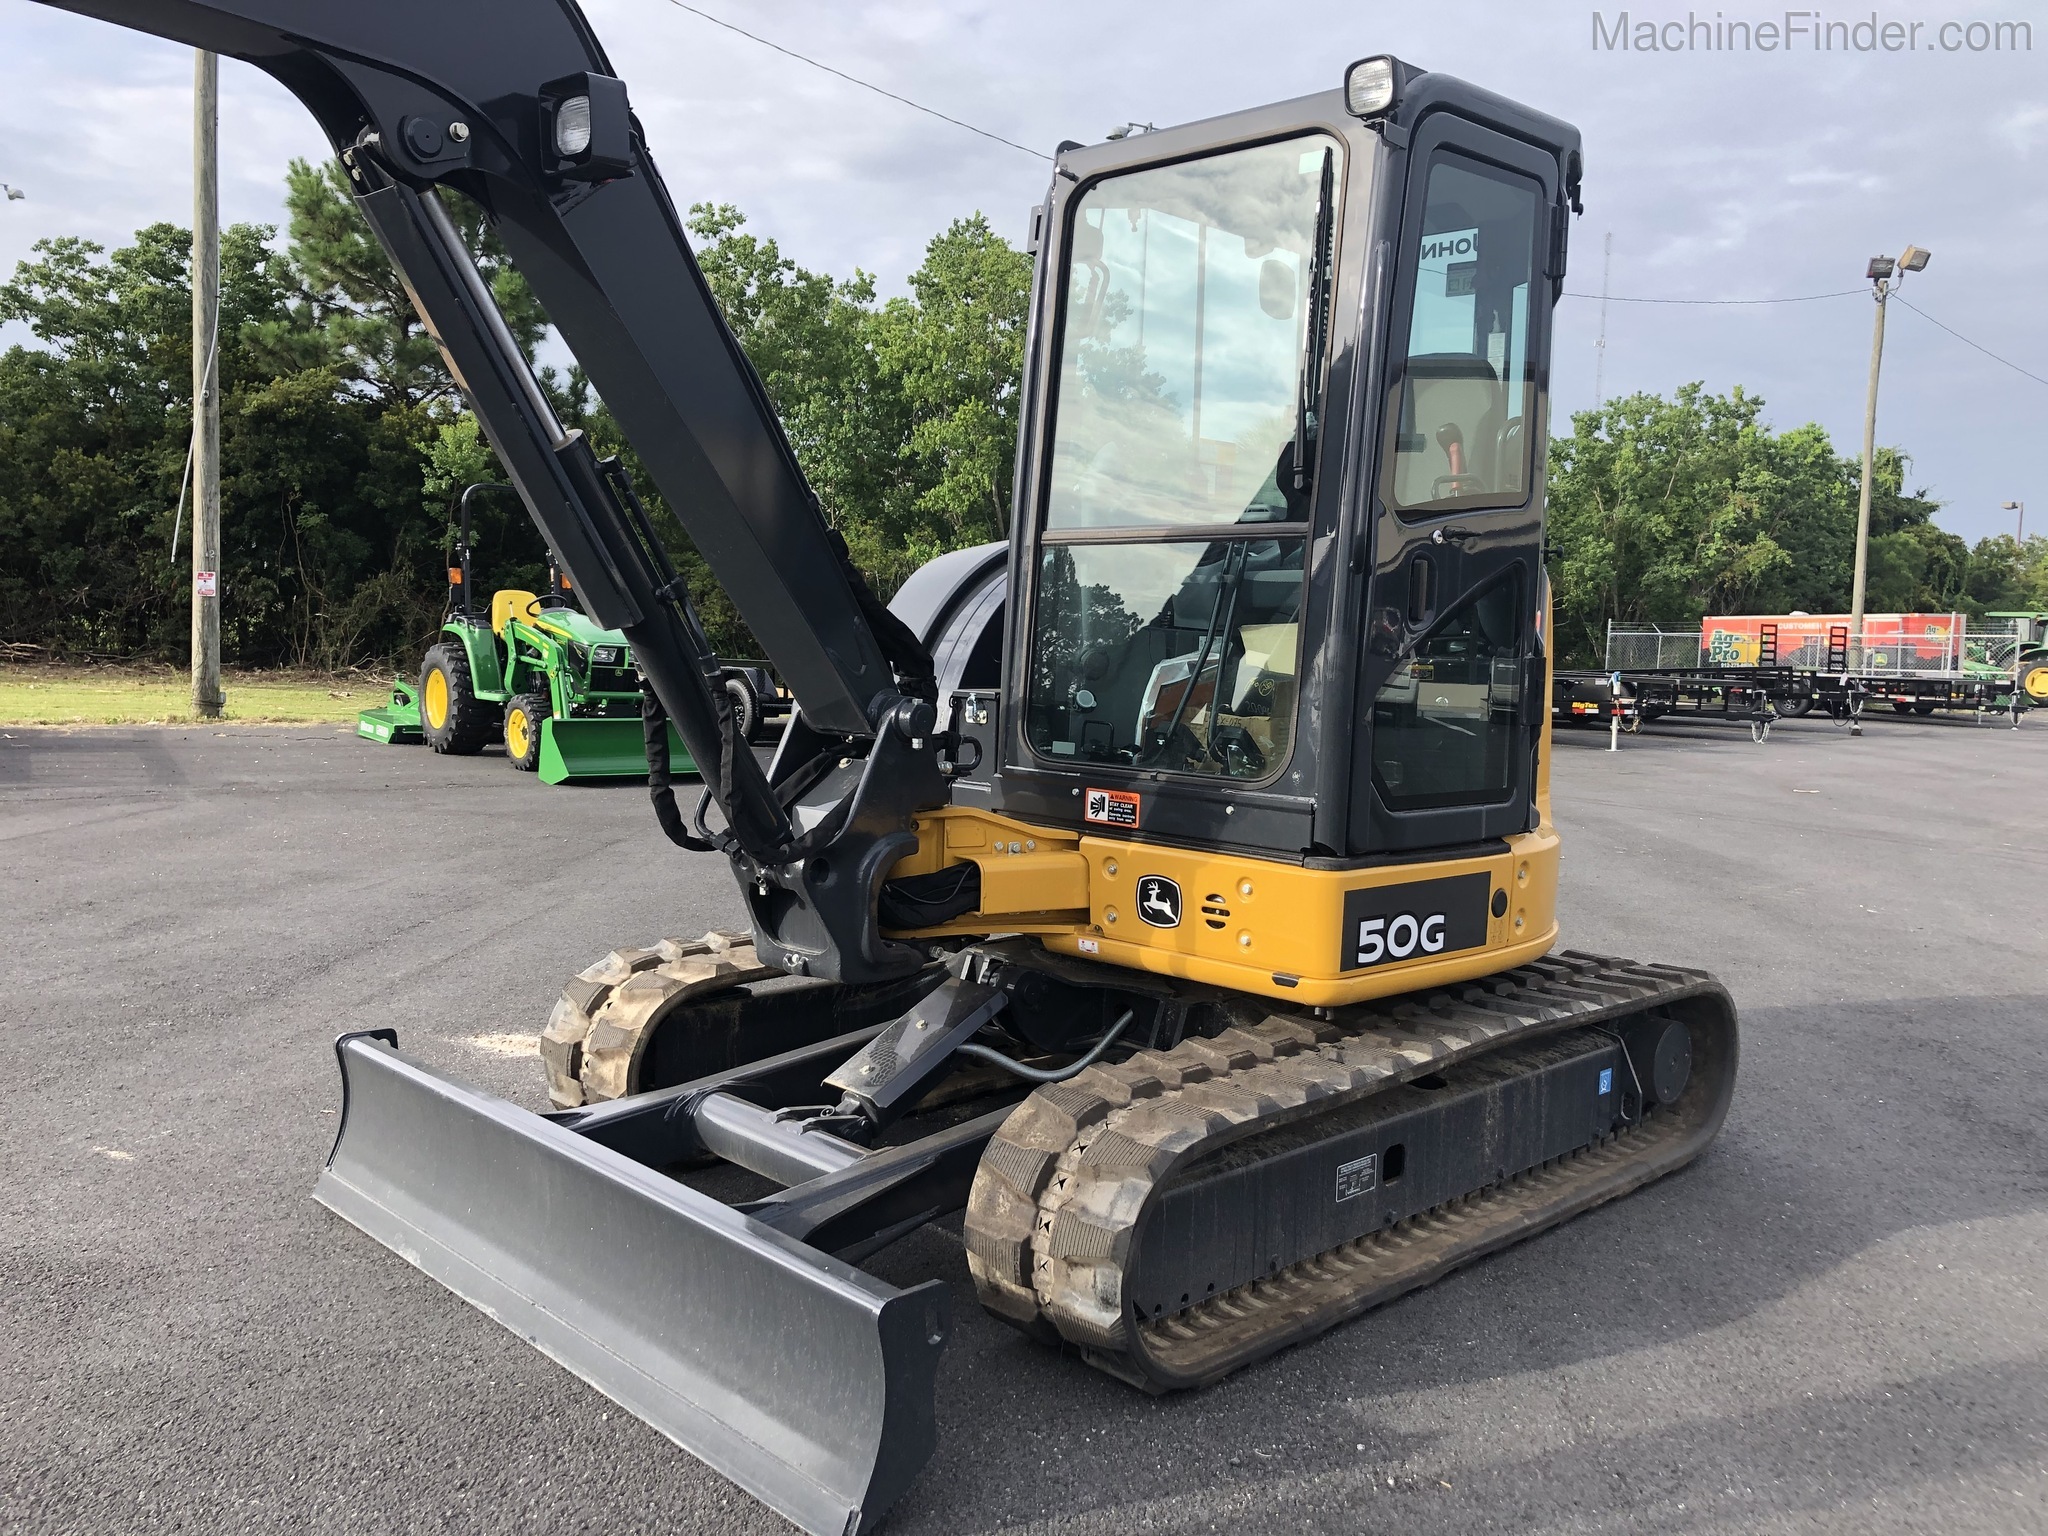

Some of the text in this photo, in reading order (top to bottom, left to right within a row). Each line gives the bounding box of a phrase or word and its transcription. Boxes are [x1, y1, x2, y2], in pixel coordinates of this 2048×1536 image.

[1710, 629, 1742, 649] Ag-
[1709, 645, 1740, 662] Pro
[1357, 914, 1445, 964] 50G
